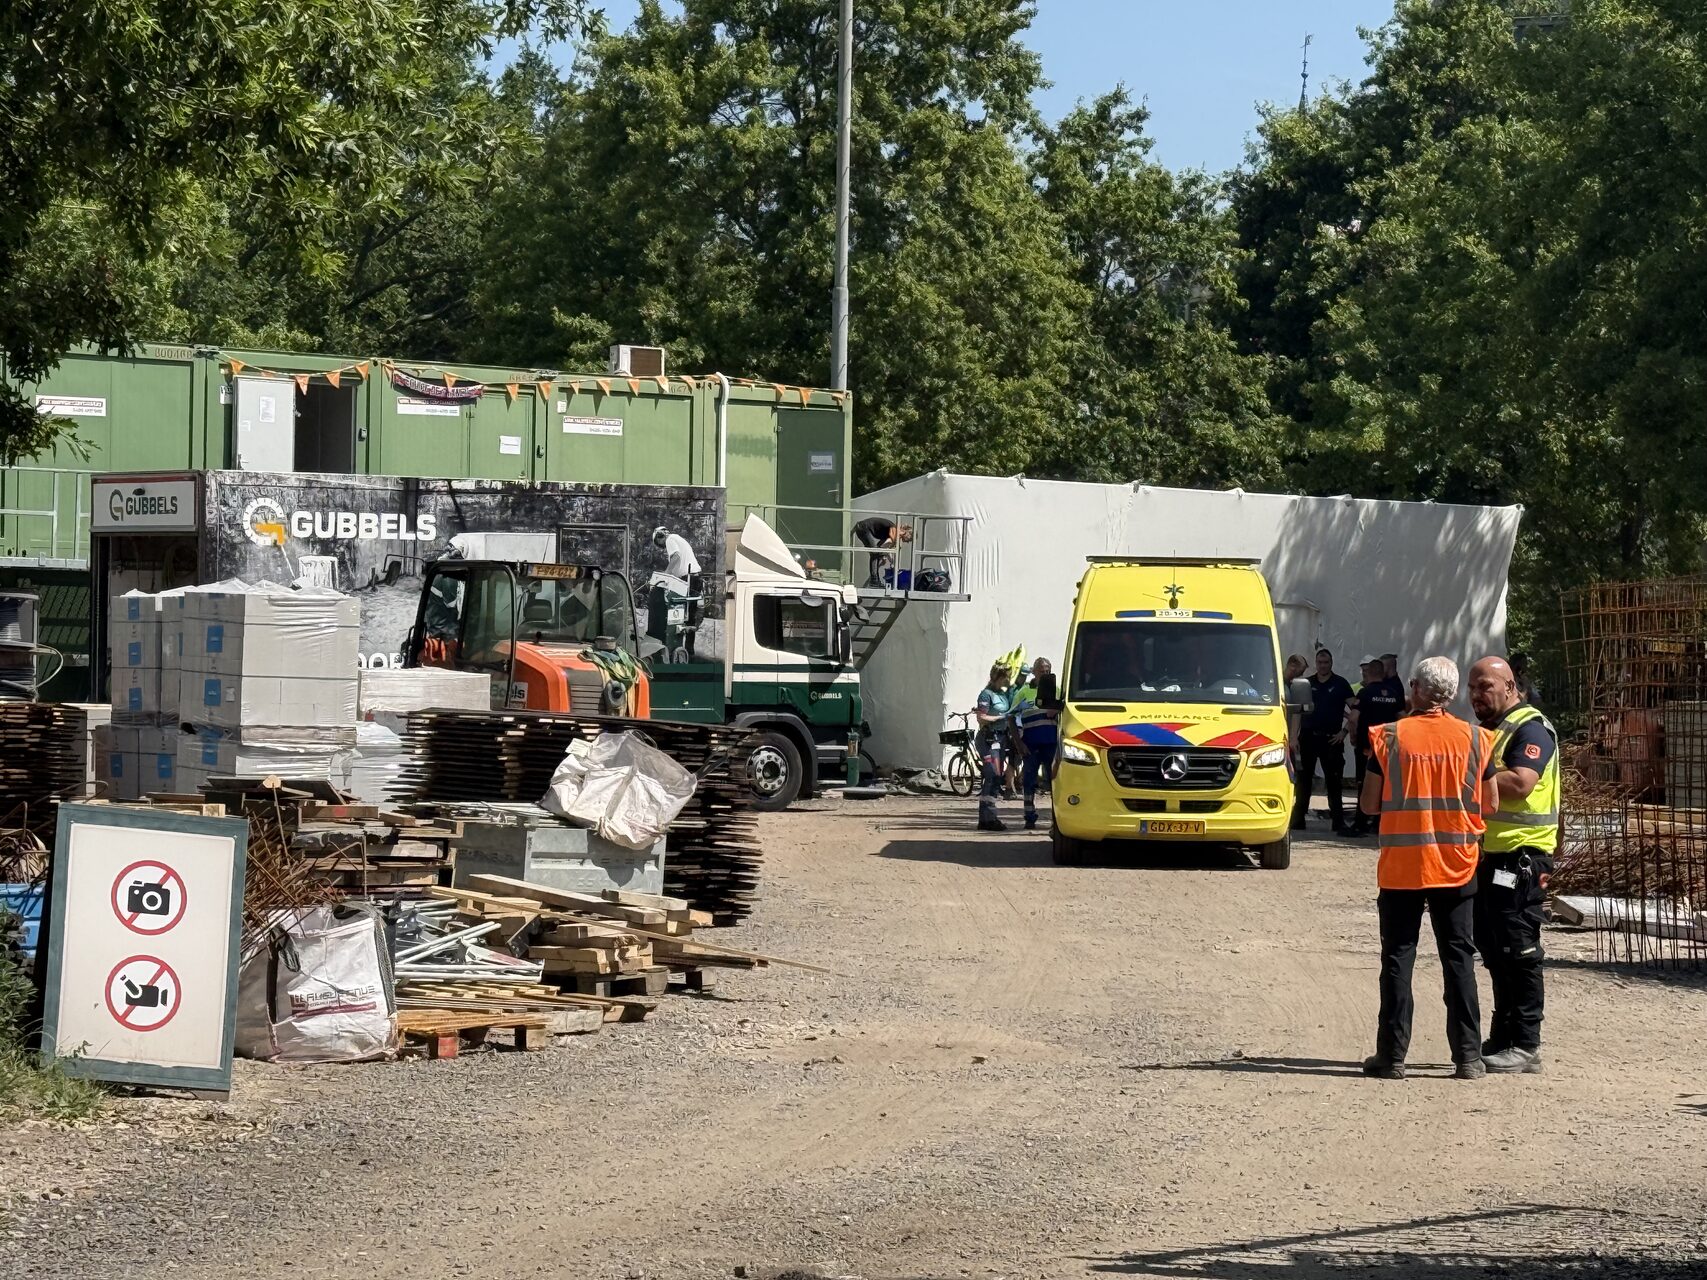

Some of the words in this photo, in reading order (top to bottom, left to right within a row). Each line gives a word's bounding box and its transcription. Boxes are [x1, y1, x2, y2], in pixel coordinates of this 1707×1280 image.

[125, 496, 178, 515] GUBBELS
[291, 510, 437, 541] GUBBELS
[490, 684, 525, 699] Bols
[1129, 714, 1220, 722] AMBULANCE
